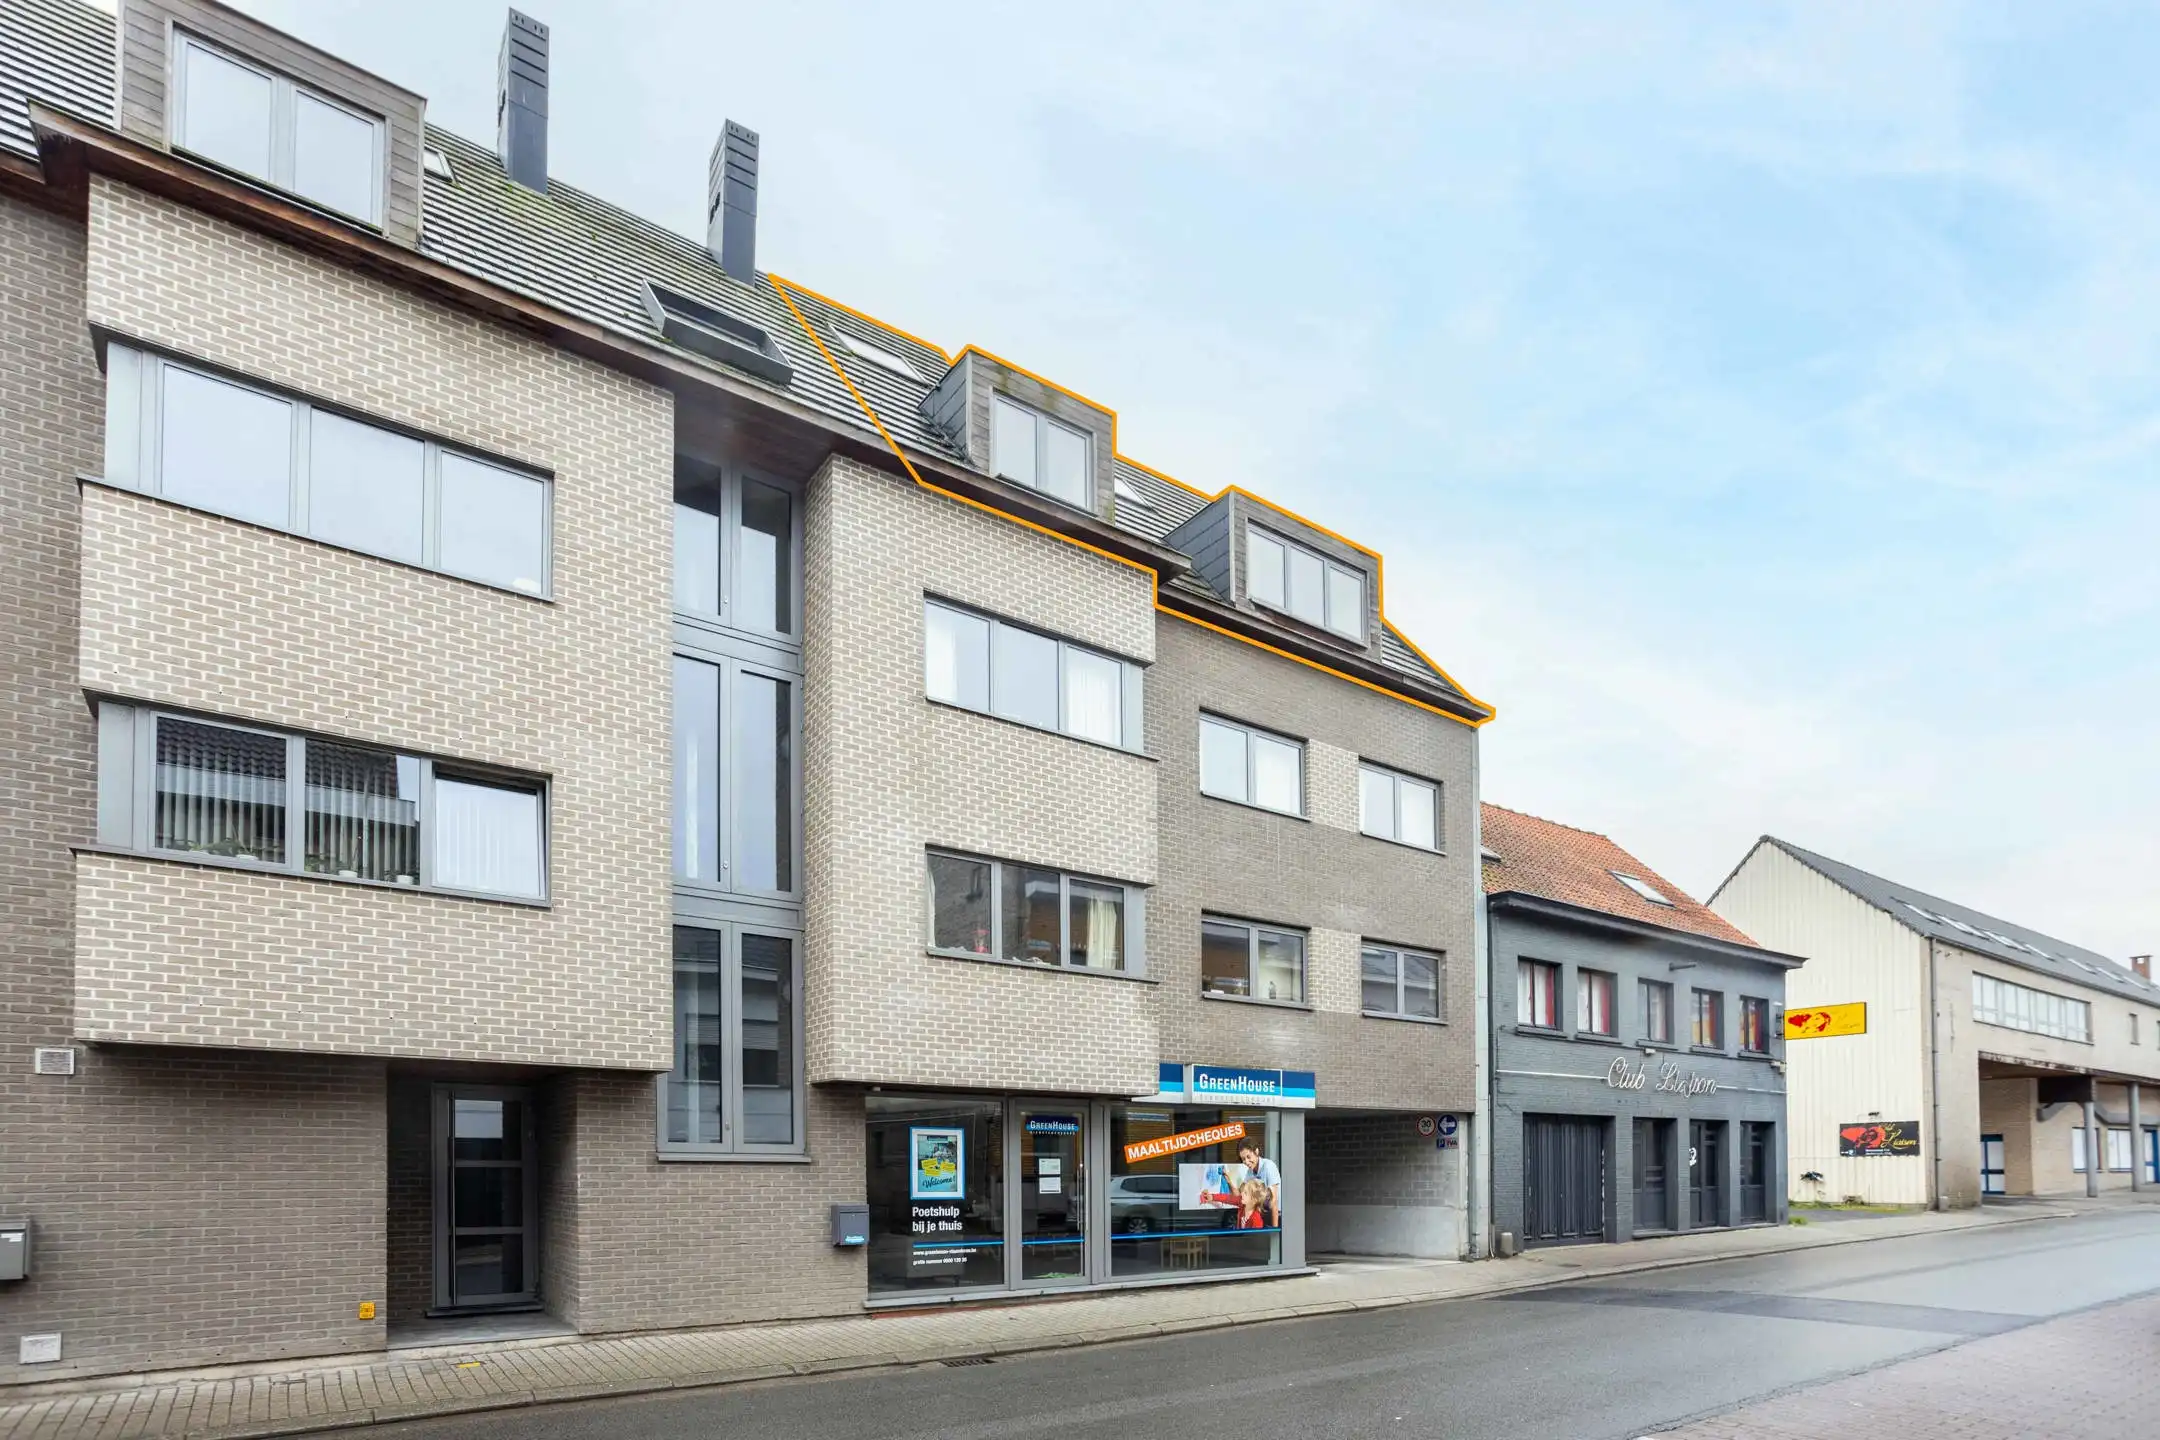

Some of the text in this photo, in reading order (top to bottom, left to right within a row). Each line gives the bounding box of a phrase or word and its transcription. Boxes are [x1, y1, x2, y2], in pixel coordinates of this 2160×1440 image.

[1608, 1056, 1645, 1090] Club
[1127, 1123, 1243, 1160] MAALTIJDCHEQUES
[912, 1206, 960, 1218] Poetshulp
[912, 1220, 963, 1234] bij je thuis
